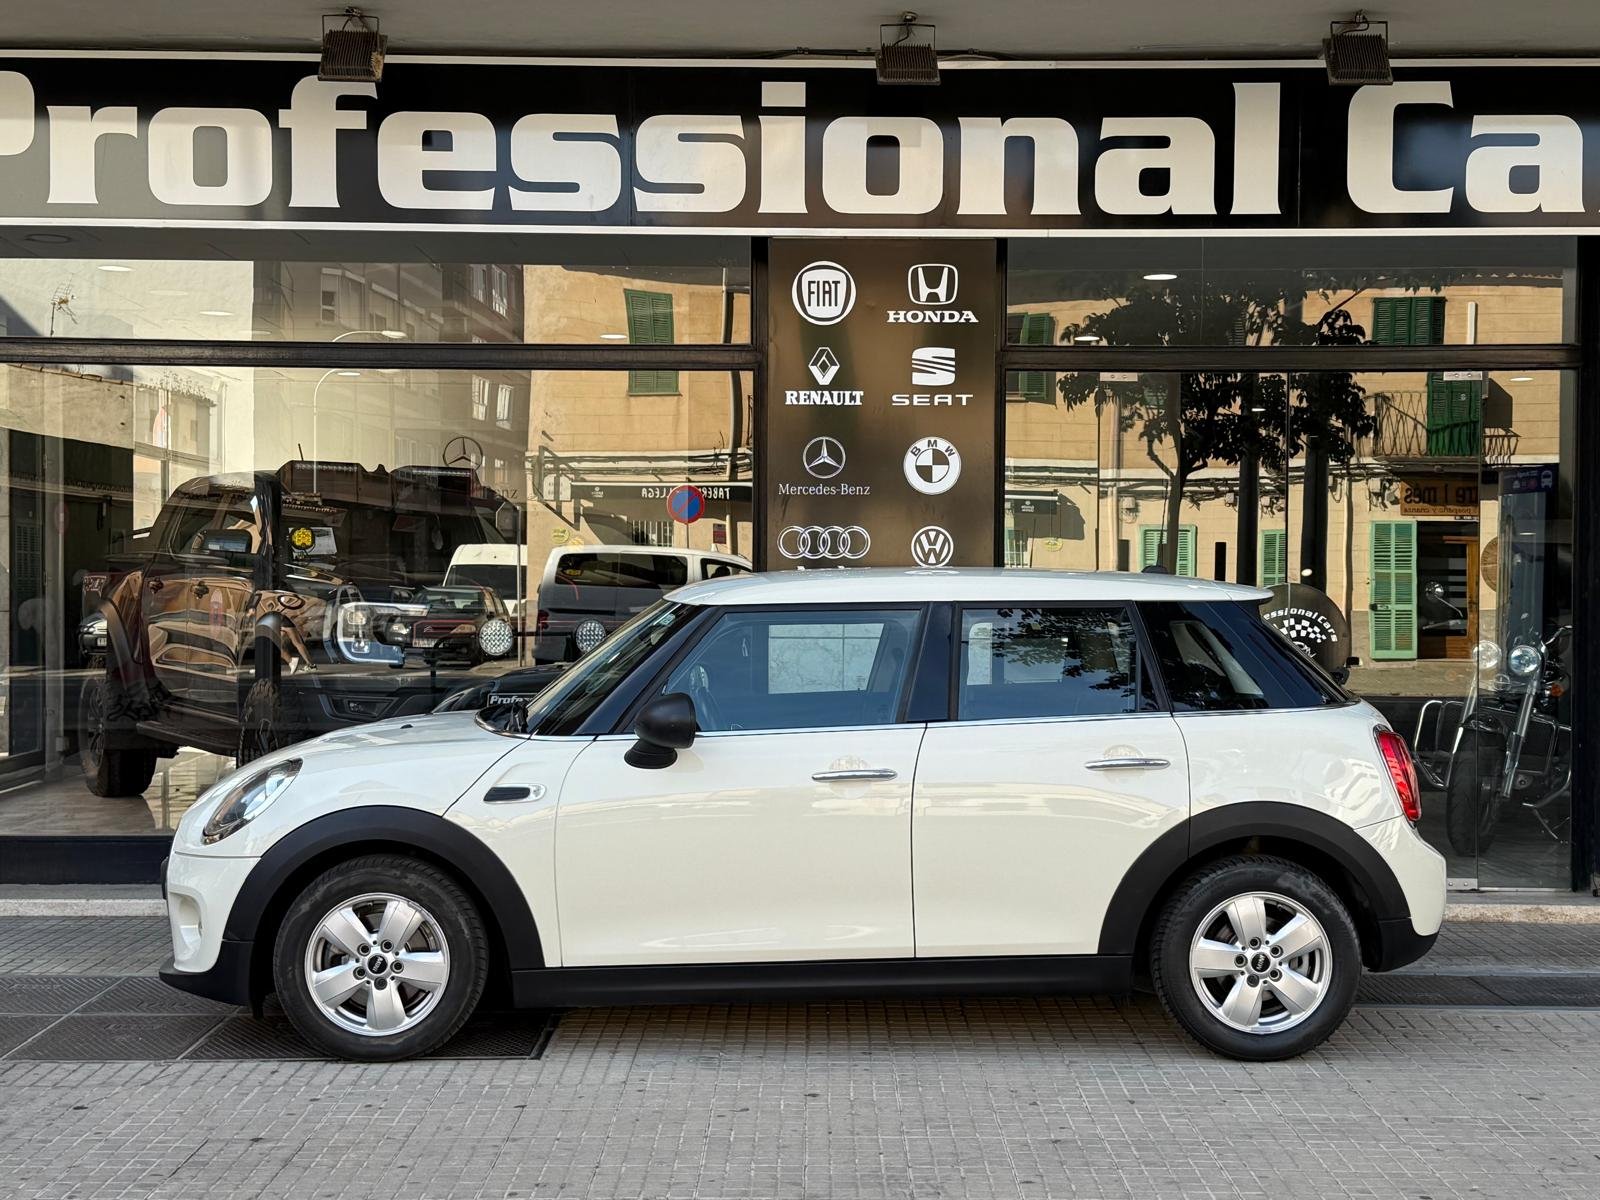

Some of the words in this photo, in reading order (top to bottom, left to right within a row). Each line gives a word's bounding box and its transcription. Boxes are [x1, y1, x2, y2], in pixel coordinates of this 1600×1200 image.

[1346, 81, 1600, 214] Ca
[808, 281, 840, 307] FIAT
[887, 311, 979, 323] HONDA
[785, 390, 864, 406] RENAULT
[891, 394, 973, 406] SEAT
[911, 439, 956, 457] BMW
[778, 484, 871, 495] Mercedes-Benz
[1263, 607, 1318, 620] essional
[490, 695, 533, 704] Profe
